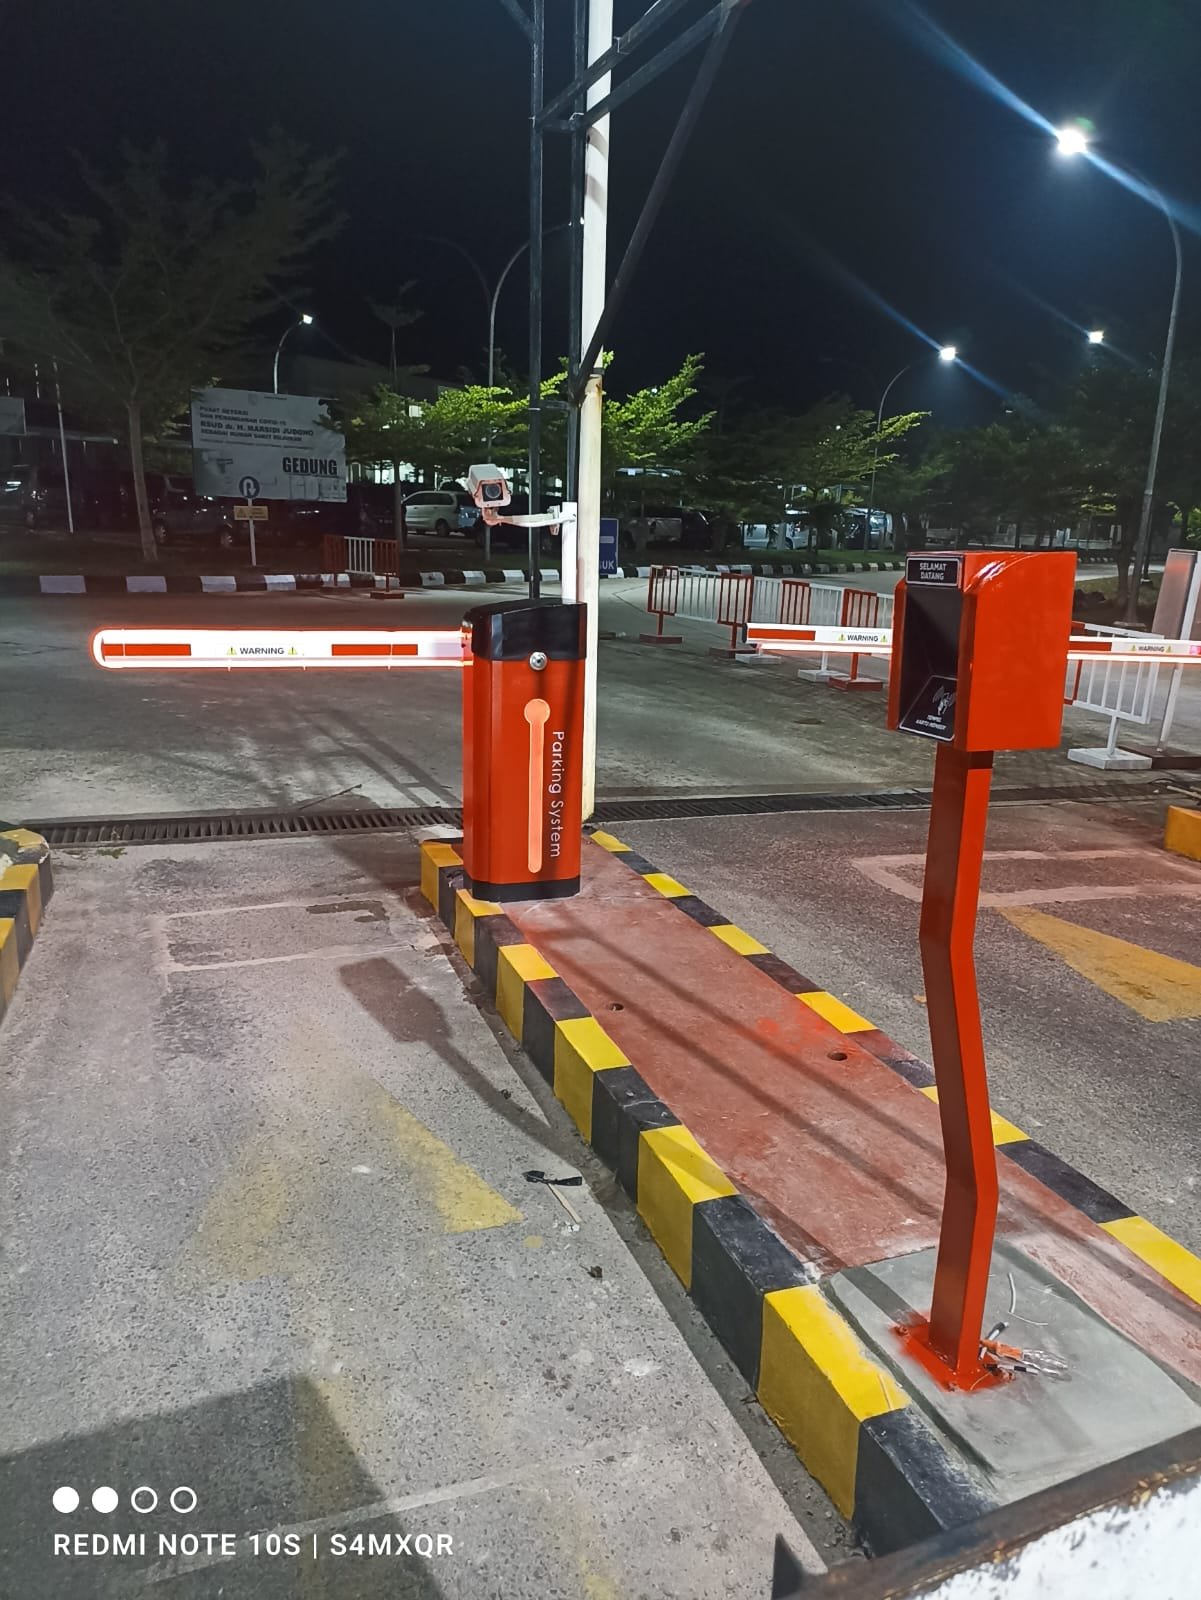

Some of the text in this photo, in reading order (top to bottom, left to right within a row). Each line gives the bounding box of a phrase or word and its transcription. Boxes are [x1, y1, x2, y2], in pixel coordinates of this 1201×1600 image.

[201, 421, 223, 429] RSUD
[248, 426, 281, 434] MARSIDI
[282, 456, 338, 476] GEDUNG
[600, 560, 615, 570] UK
[919, 562, 947, 571] SELAMAT
[920, 571, 945, 581] DATANG
[847, 634, 879, 642] WARNING
[239, 647, 285, 655] WARNING
[1138, 645, 1166, 653] WARNING
[548, 731, 565, 858] Parking System
